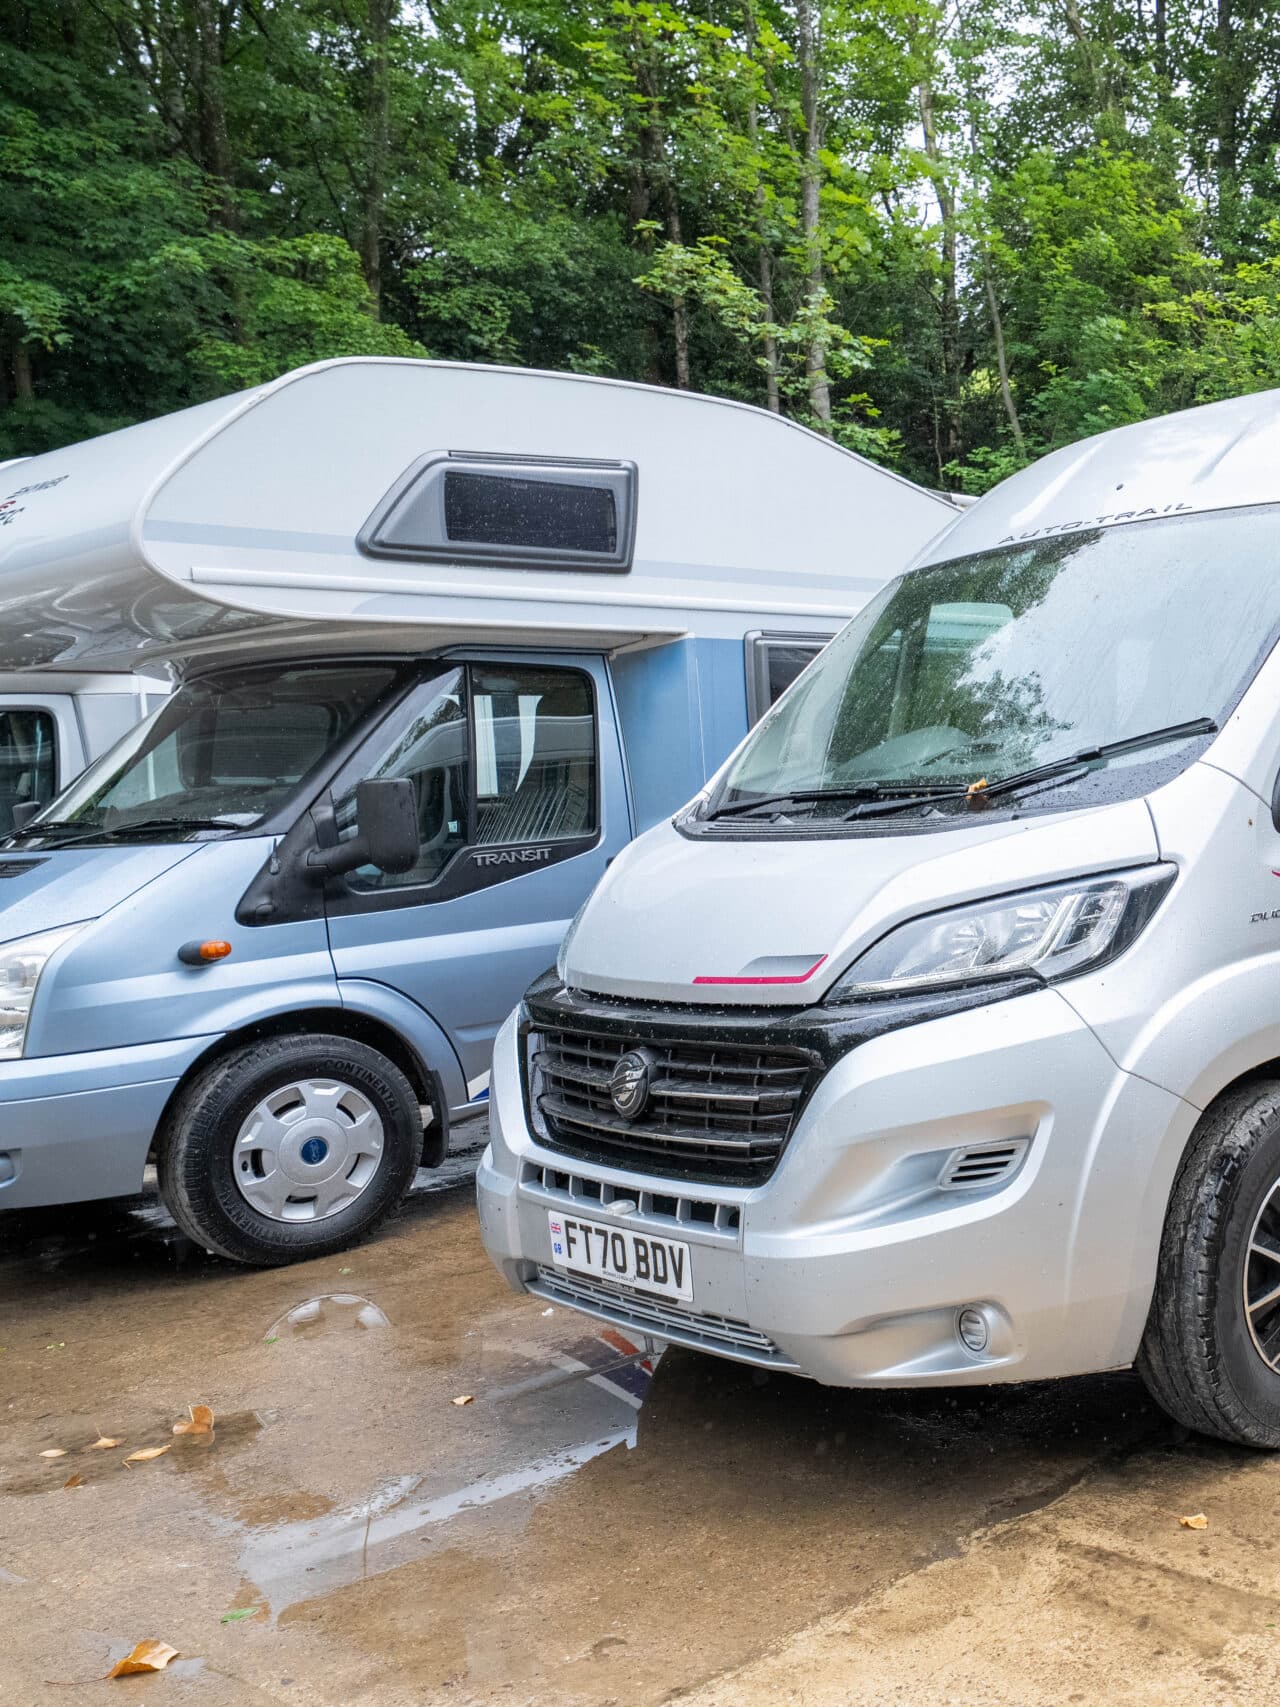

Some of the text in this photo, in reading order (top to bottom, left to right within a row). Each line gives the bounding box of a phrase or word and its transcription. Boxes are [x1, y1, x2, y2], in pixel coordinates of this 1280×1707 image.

[998, 502, 1193, 545] AUTO-TRAIL
[473, 847, 552, 866] TRANSIT
[324, 1060, 399, 1116] CONTINENTAL
[564, 1219, 684, 1289] FT70 BDV
